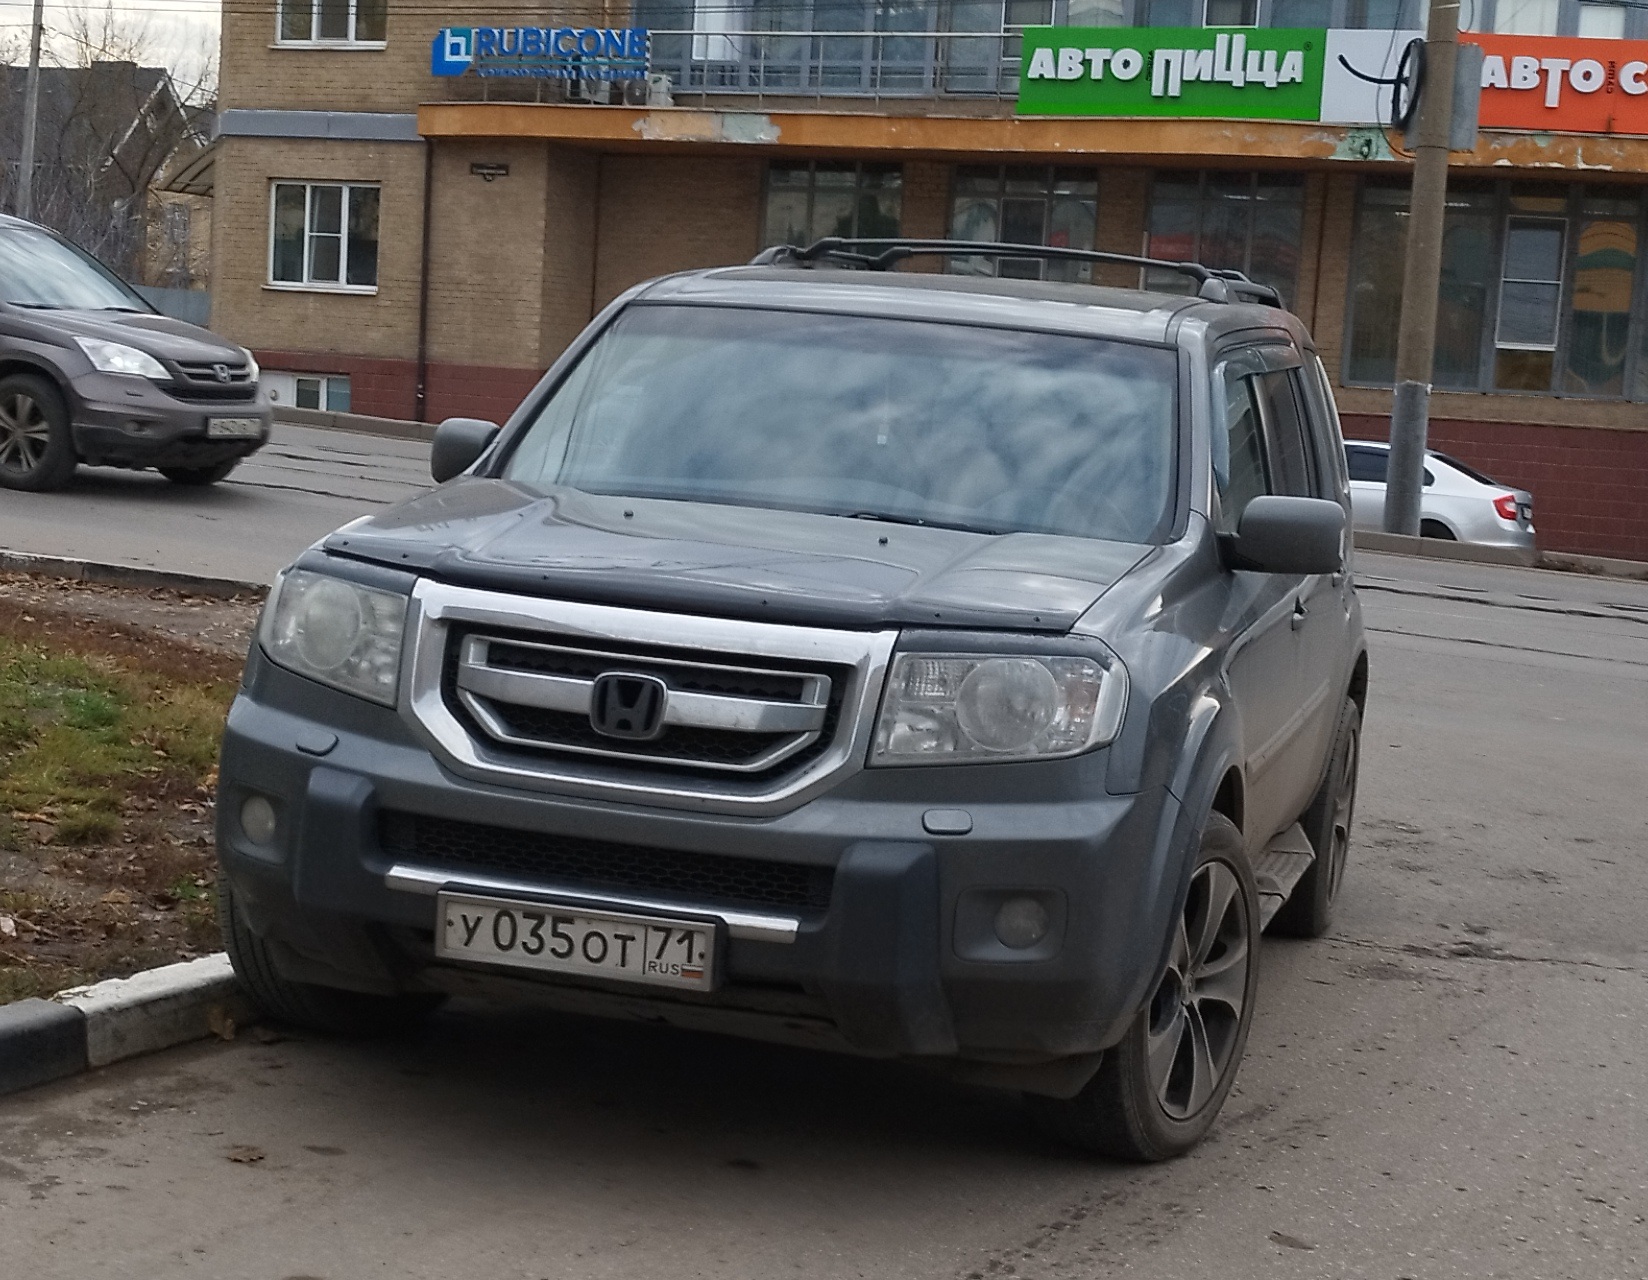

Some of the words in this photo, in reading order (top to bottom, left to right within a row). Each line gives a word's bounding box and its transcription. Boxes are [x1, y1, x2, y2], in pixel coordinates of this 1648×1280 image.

[476, 28, 648, 57] RUBICONE
[1027, 47, 1144, 80] АВТО
[1481, 55, 1606, 108] АВТО
[648, 960, 680, 976] RUS
